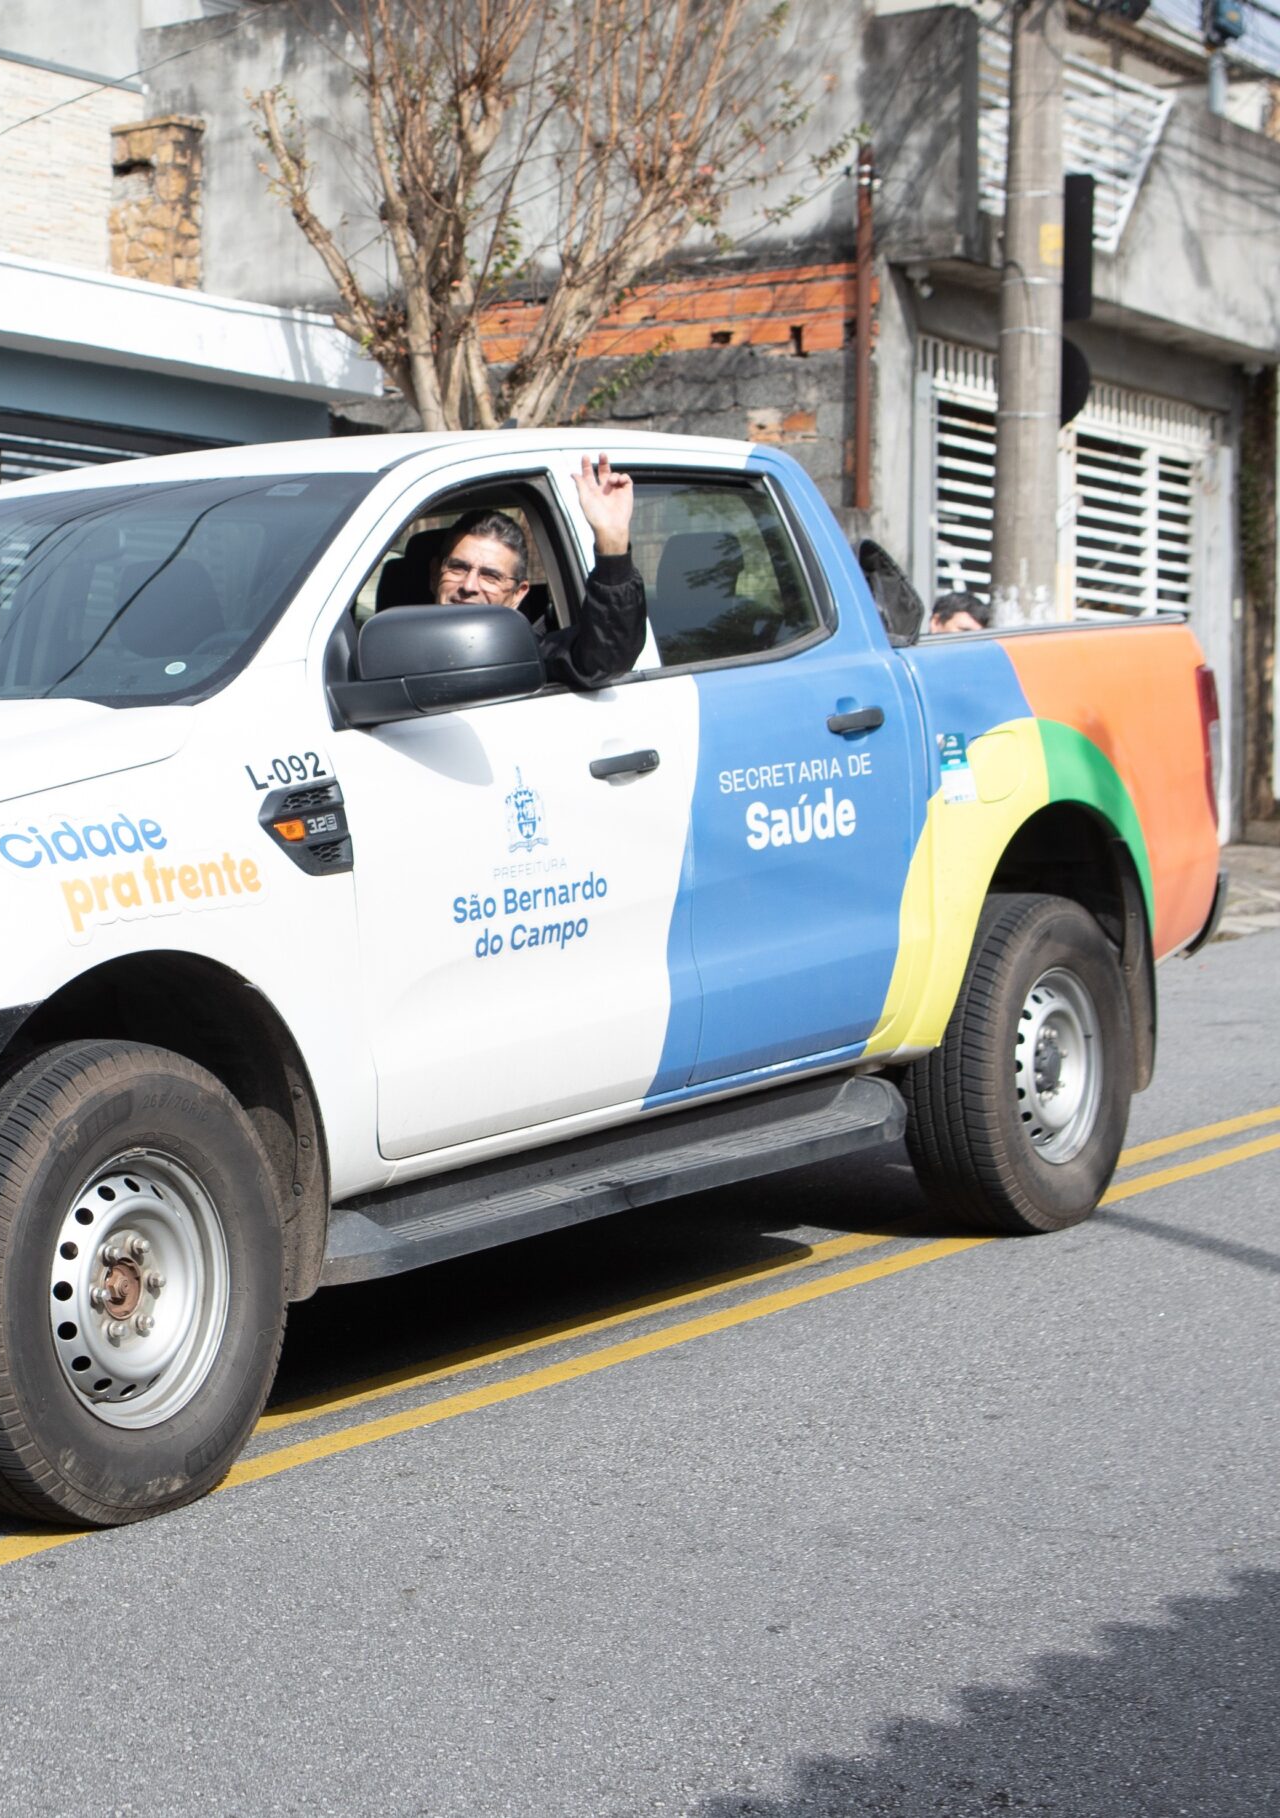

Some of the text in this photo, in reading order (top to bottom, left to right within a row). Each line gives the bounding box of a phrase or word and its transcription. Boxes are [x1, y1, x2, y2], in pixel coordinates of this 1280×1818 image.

[244, 751, 327, 791] L-092
[718, 752, 873, 794] SECRETARIA DE
[745, 787, 857, 850] Saúde
[493, 857, 568, 881] PREFEITURA
[60, 852, 262, 932] pra frente
[453, 871, 608, 924] São Bernardo
[475, 917, 588, 958] do Campo
